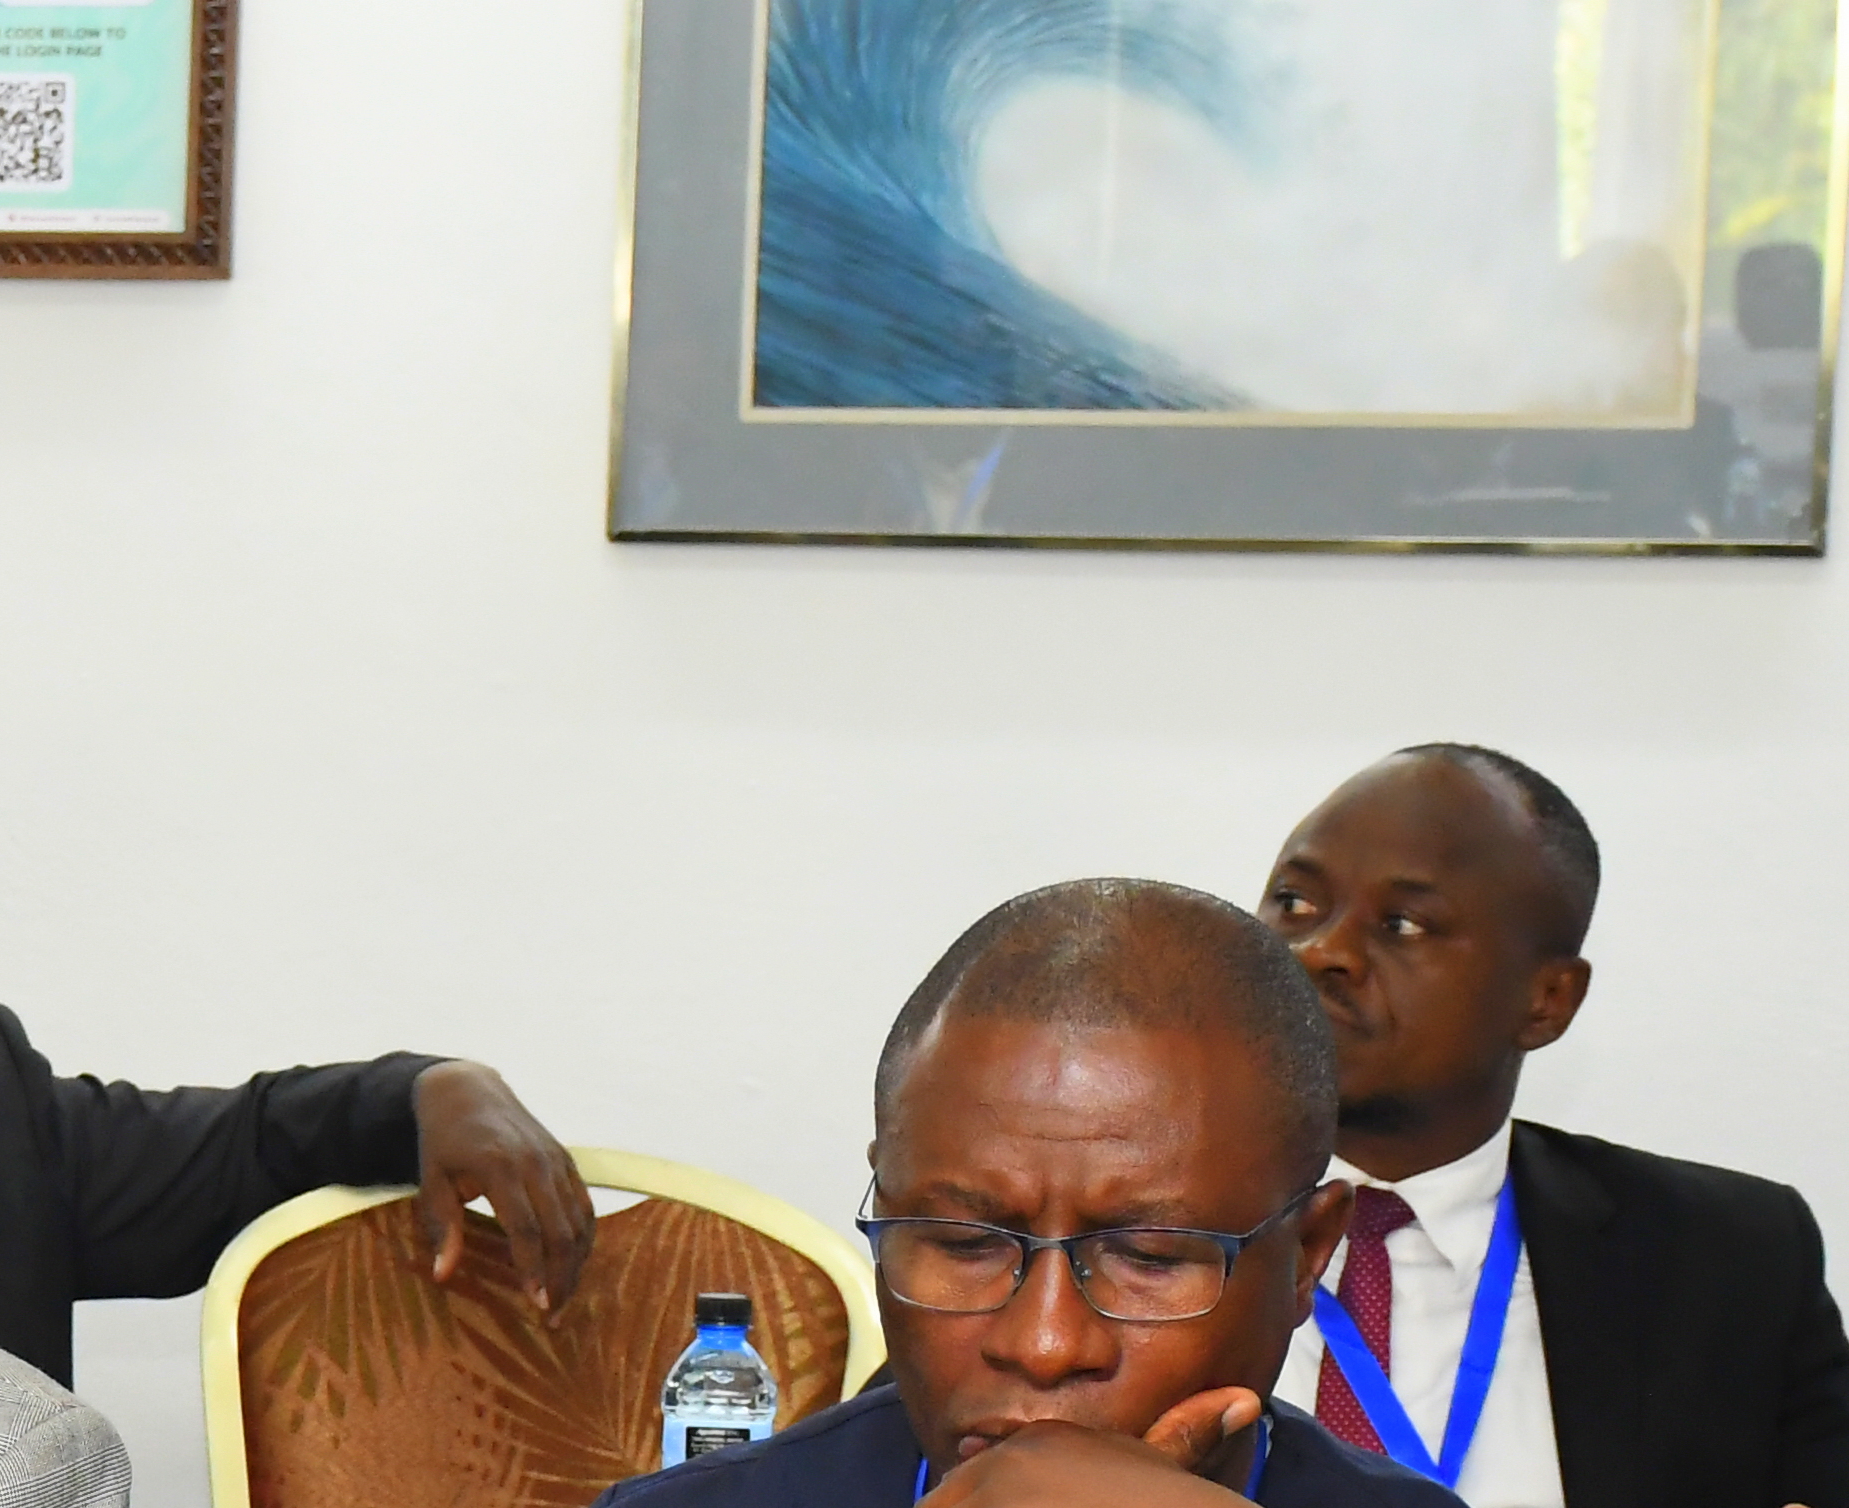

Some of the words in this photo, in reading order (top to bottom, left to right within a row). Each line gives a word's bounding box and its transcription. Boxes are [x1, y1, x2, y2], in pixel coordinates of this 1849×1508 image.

[5, 27, 44, 40] CODE
[50, 27, 102, 40] BELOW
[105, 28, 127, 40] TO
[16, 45, 61, 57] LOGIN
[65, 45, 103, 57] PAGE
